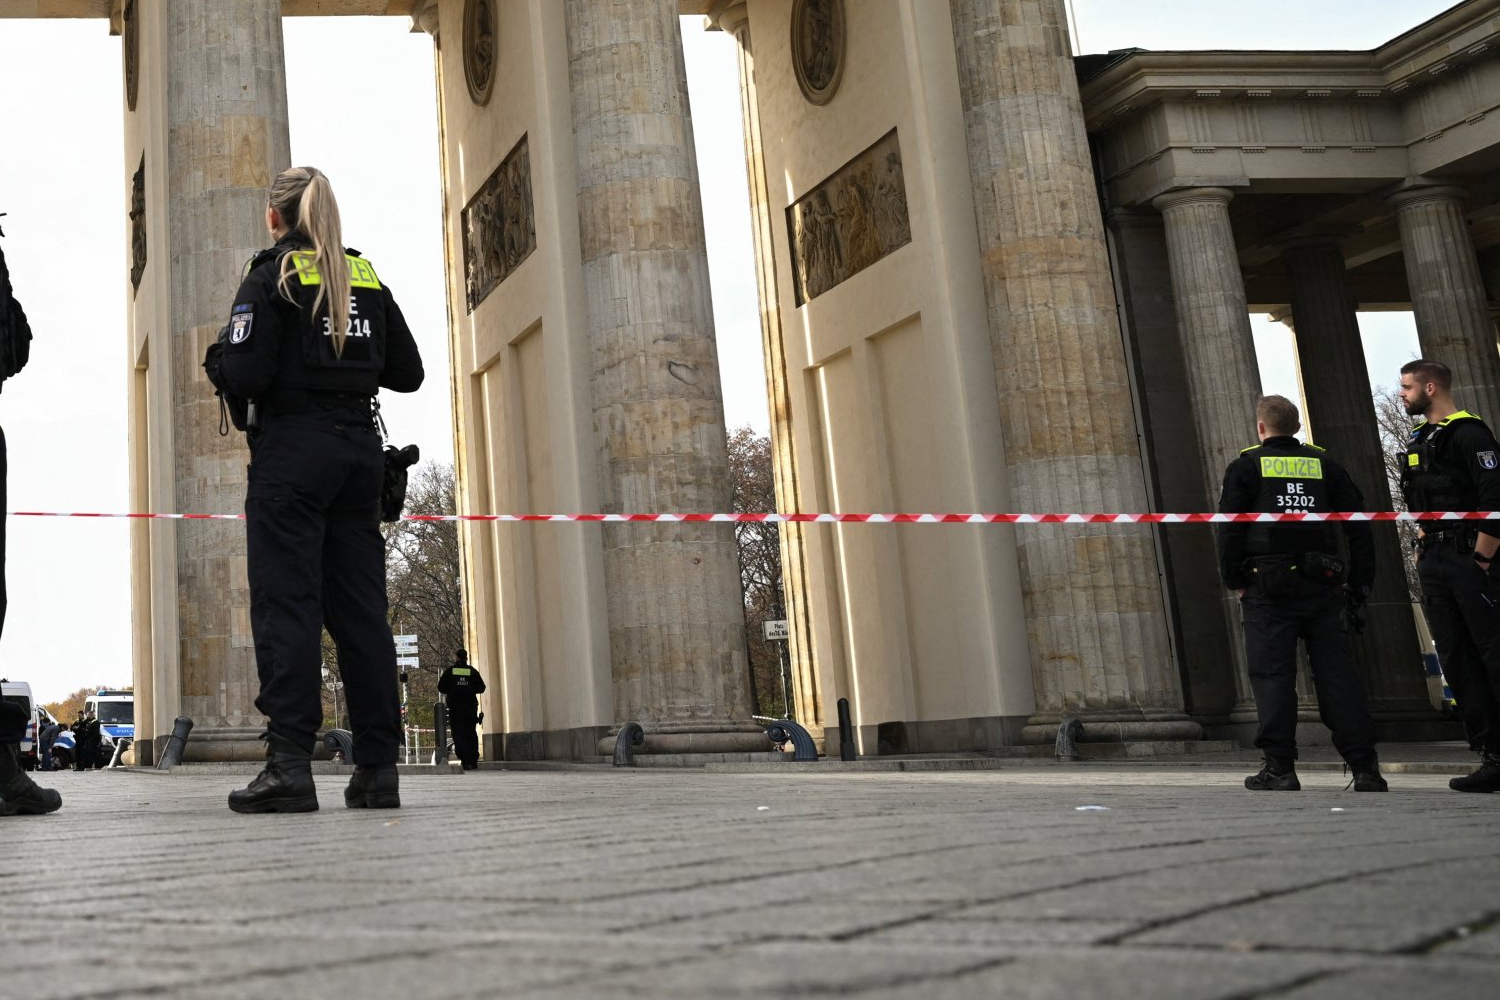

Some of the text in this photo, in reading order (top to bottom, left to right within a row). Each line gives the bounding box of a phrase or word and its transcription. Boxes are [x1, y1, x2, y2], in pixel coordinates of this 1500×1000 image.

[322, 317, 371, 338] 3214
[1263, 459, 1320, 477] POLIZEI
[1287, 483, 1304, 494] BE
[1276, 496, 1315, 507] 35202
